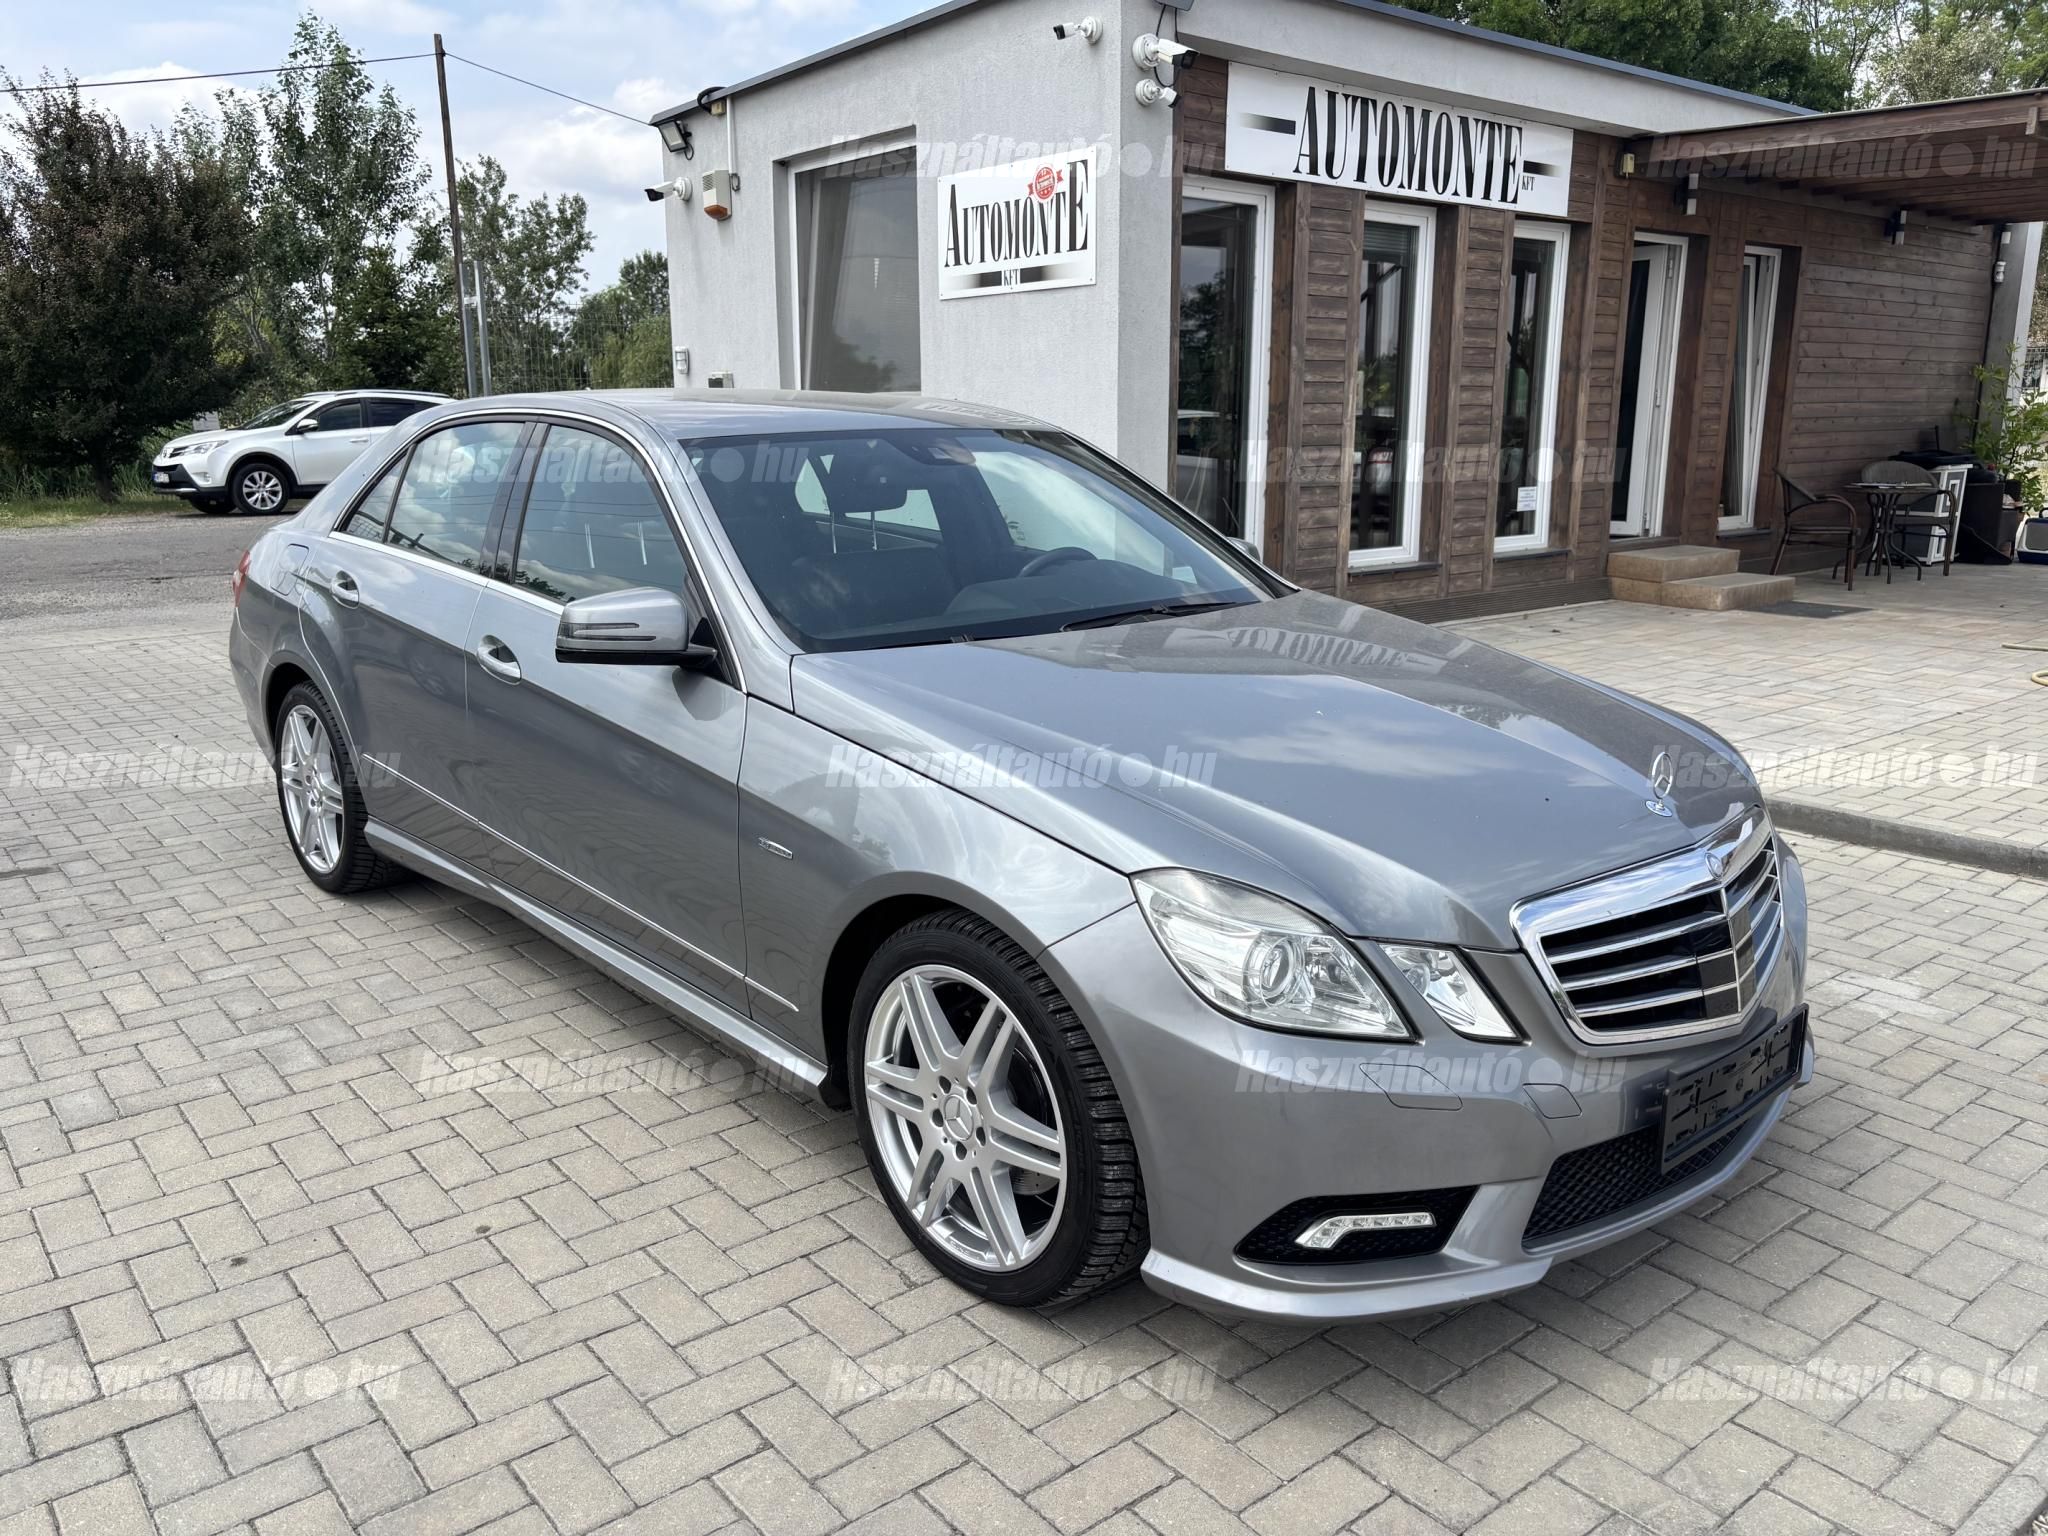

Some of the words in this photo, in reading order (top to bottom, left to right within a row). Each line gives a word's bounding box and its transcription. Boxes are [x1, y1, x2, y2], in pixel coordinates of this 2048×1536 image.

[1293, 86, 1523, 205] AUTOMONTE
[944, 159, 1089, 268] AUTOMONTE
[1521, 175, 1536, 191] KFT
[1003, 268, 1020, 286] KFT
